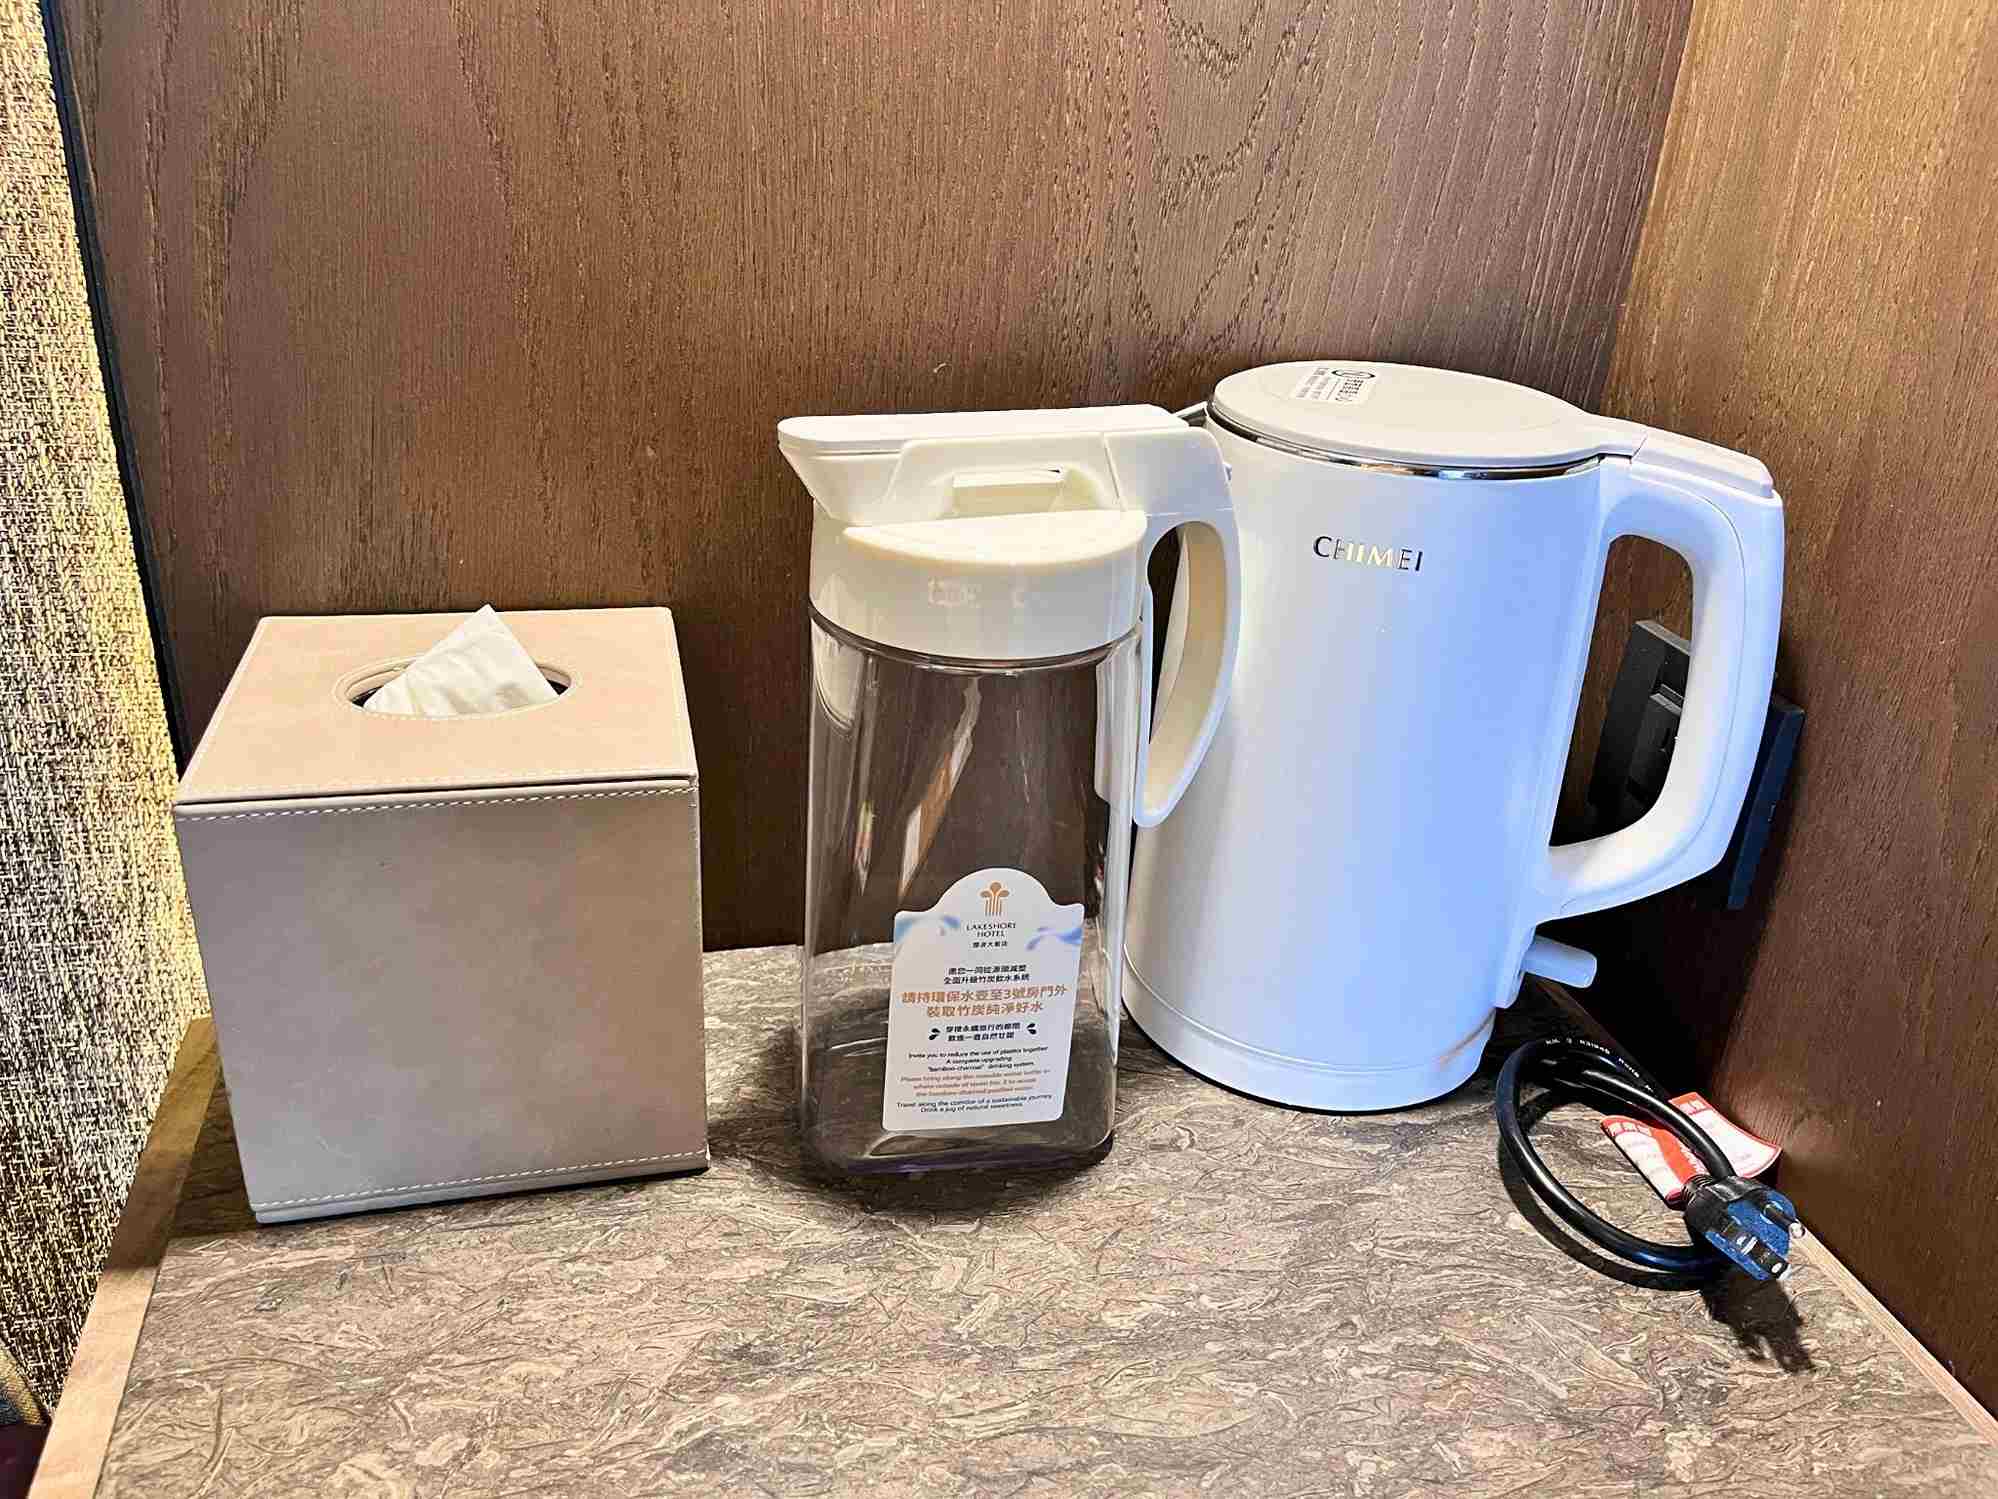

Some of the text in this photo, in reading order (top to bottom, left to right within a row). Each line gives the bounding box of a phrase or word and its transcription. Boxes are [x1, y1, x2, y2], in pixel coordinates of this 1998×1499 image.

[1312, 535, 1424, 572] CHIMEI
[966, 922, 1017, 931] LAKESHORE
[977, 930, 1005, 938] HOTEL
[927, 1001, 1043, 1018] 裝取竹炭純淨好水
